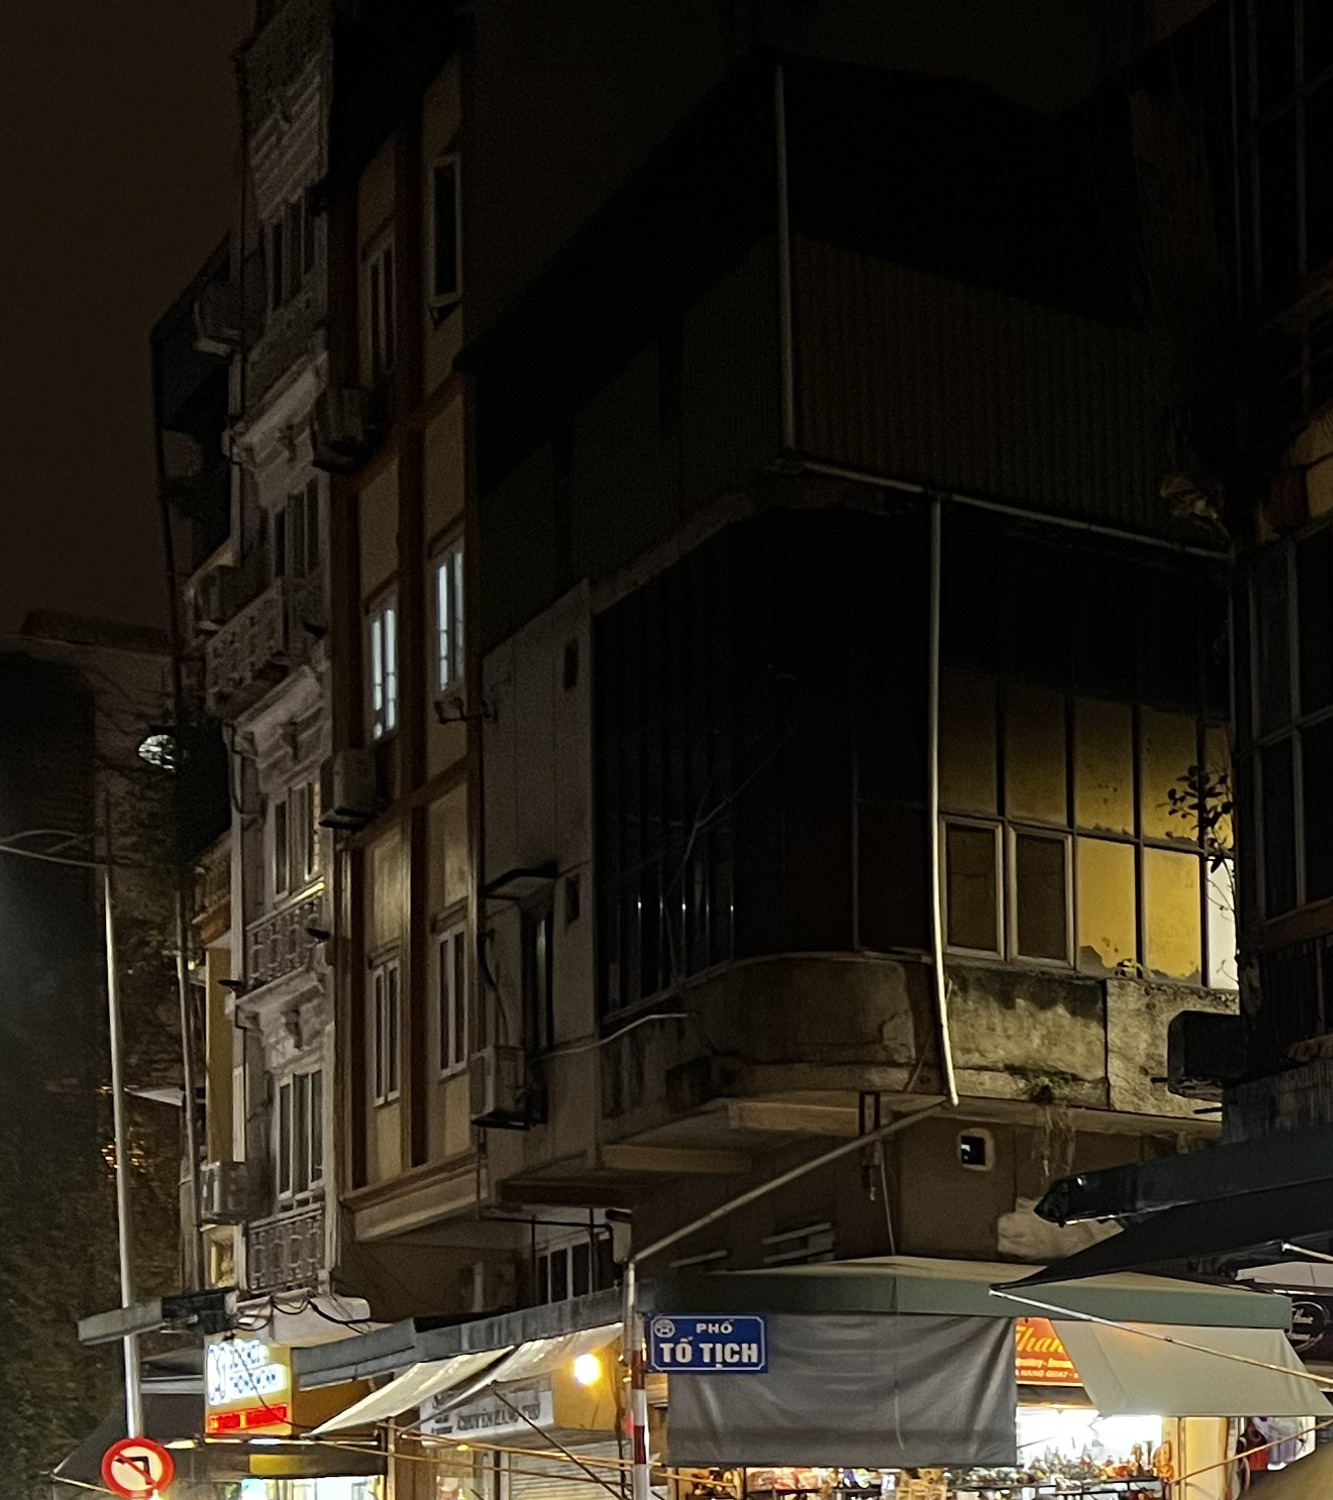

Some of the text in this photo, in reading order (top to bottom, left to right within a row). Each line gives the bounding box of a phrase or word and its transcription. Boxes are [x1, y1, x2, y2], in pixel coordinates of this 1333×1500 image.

[696, 1319, 734, 1334] PHỐ
[660, 1336, 759, 1370] TỐ TỊCH
